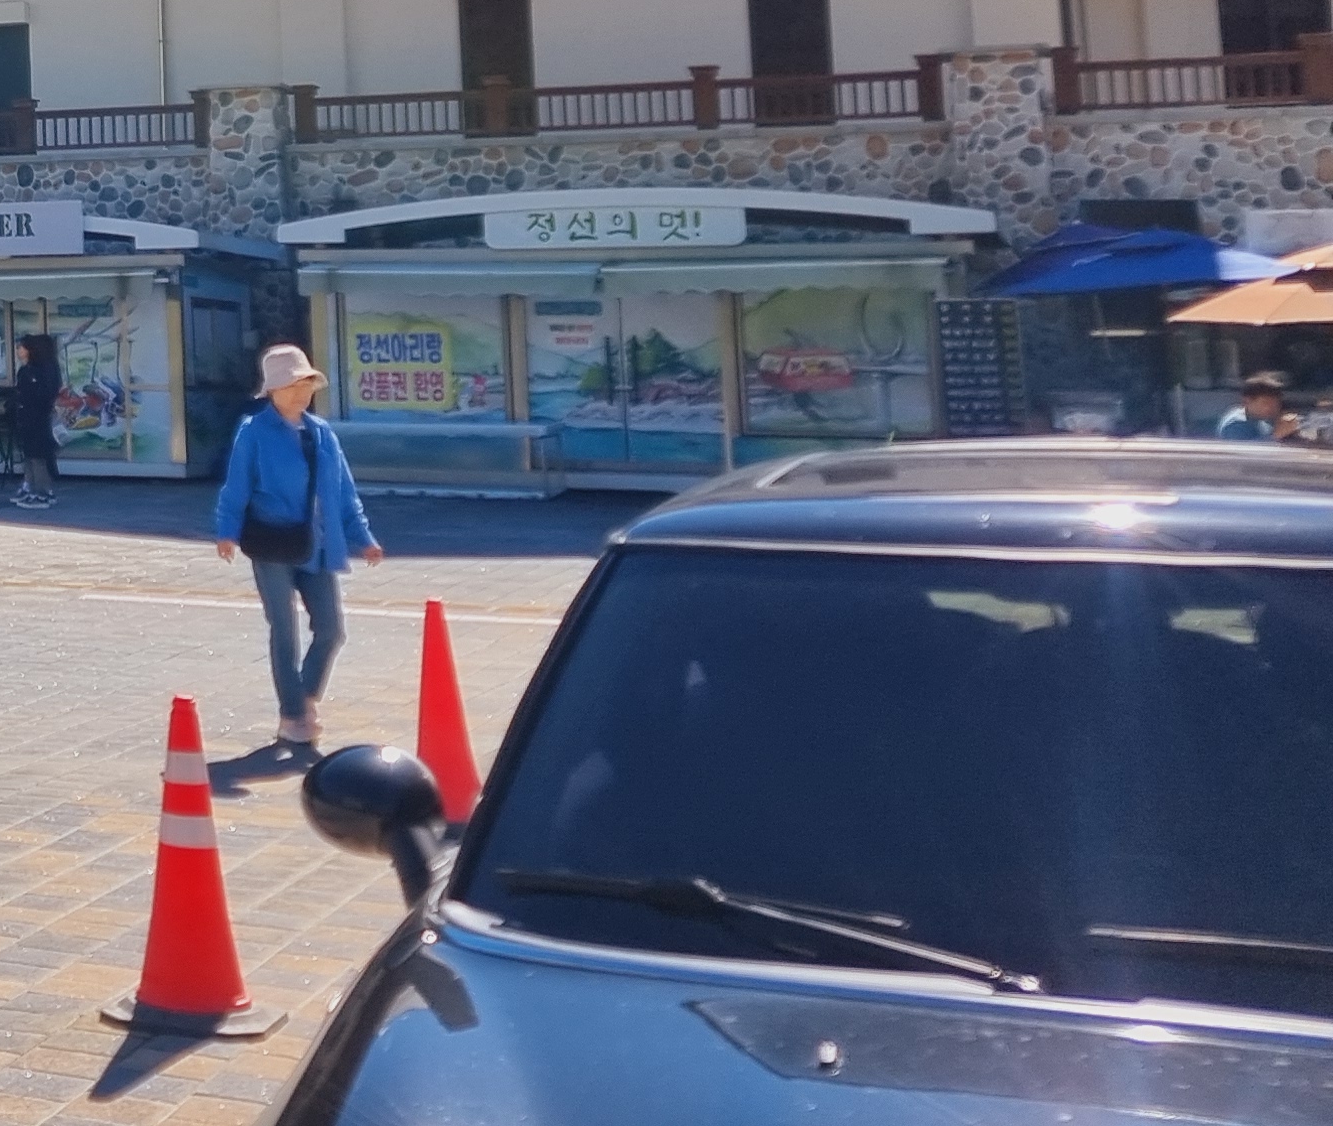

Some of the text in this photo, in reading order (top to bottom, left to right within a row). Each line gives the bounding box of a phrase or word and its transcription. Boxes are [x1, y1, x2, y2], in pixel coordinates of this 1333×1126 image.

[527, 209, 702, 242] 정선의 멋!
[356, 332, 443, 364] 정선아리랑
[358, 371, 445, 402] 상품권 환영
